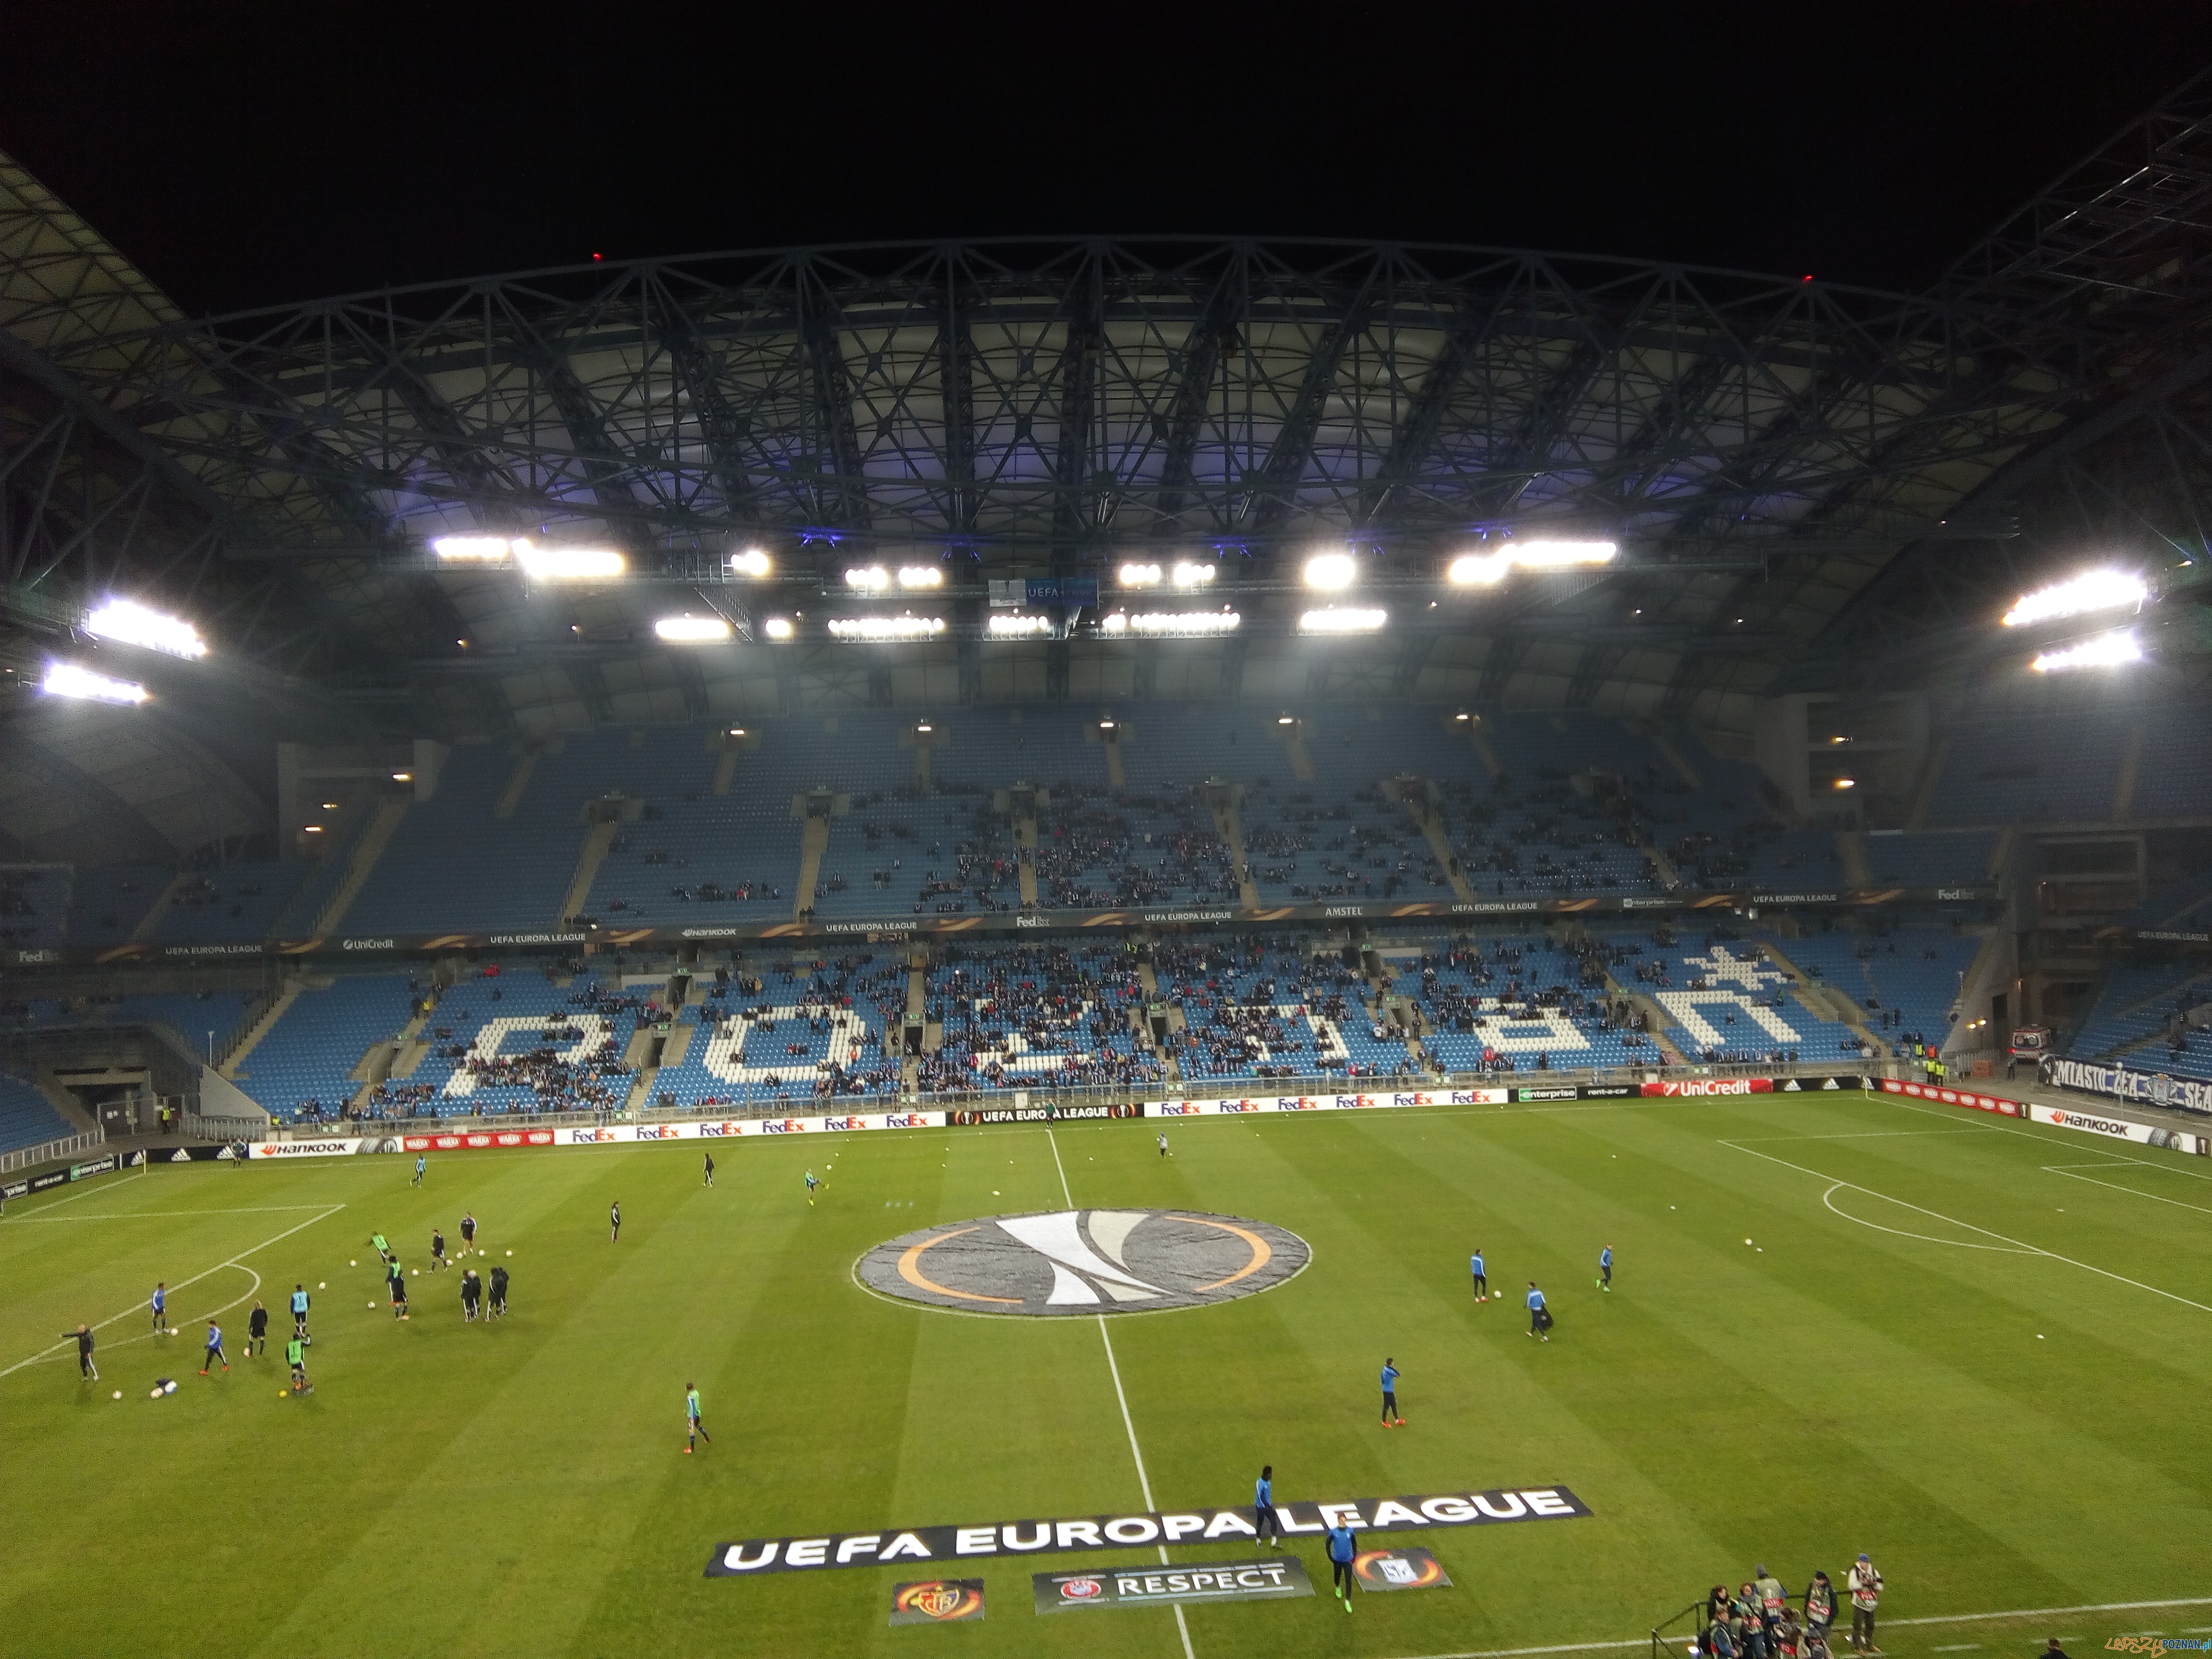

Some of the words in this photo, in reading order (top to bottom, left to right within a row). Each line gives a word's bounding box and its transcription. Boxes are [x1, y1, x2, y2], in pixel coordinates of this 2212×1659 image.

[1028, 588, 1059, 597] UEFA
[1807, 894, 1837, 902] LEAGUE
[1144, 914, 1166, 922] UEFA
[1168, 912, 1199, 921] EUROPA
[1201, 911, 1231, 920] LEAGUE
[1325, 906, 1362, 916] AMSTEL
[826, 924, 849, 932] UEFA
[851, 923, 883, 931] EUROPA
[1016, 916, 1050, 927] FedEx
[354, 938, 394, 949] UniCredit
[490, 935, 514, 944] UEFA
[516, 934, 549, 943] EUROPA
[551, 933, 585, 942] LEAGUE
[191, 946, 225, 954] EUROPA
[228, 945, 263, 954] LEAGUE
[1520, 1089, 1576, 1100] enterprise
[1680, 1080, 1750, 1096] UniCredit
[1278, 1097, 1317, 1111] FedEx
[1336, 1095, 1375, 1108] FedEx
[1394, 1094, 1433, 1106] FedEx
[1453, 1092, 1490, 1104] FedEx
[1161, 1103, 1200, 1116] FedEx
[1220, 1100, 1259, 1113] FedEx
[886, 1114, 927, 1128] FedEx
[983, 1111, 1014, 1122] UEFA
[1016, 1108, 1061, 1121] EUROA
[1063, 1107, 1109, 1118] LEAGUE
[700, 1123, 741, 1136] FedEx
[763, 1120, 804, 1134] FedEx
[825, 1117, 866, 1130] FedEx
[573, 1129, 615, 1143] FedEx
[637, 1126, 678, 1139] FedEx
[724, 1533, 932, 1570] UEFA
[956, 1511, 1257, 1554] EUROPA
[1275, 1490, 1575, 1533] LEAGUE
[1118, 1568, 1286, 1595] RESPECT
